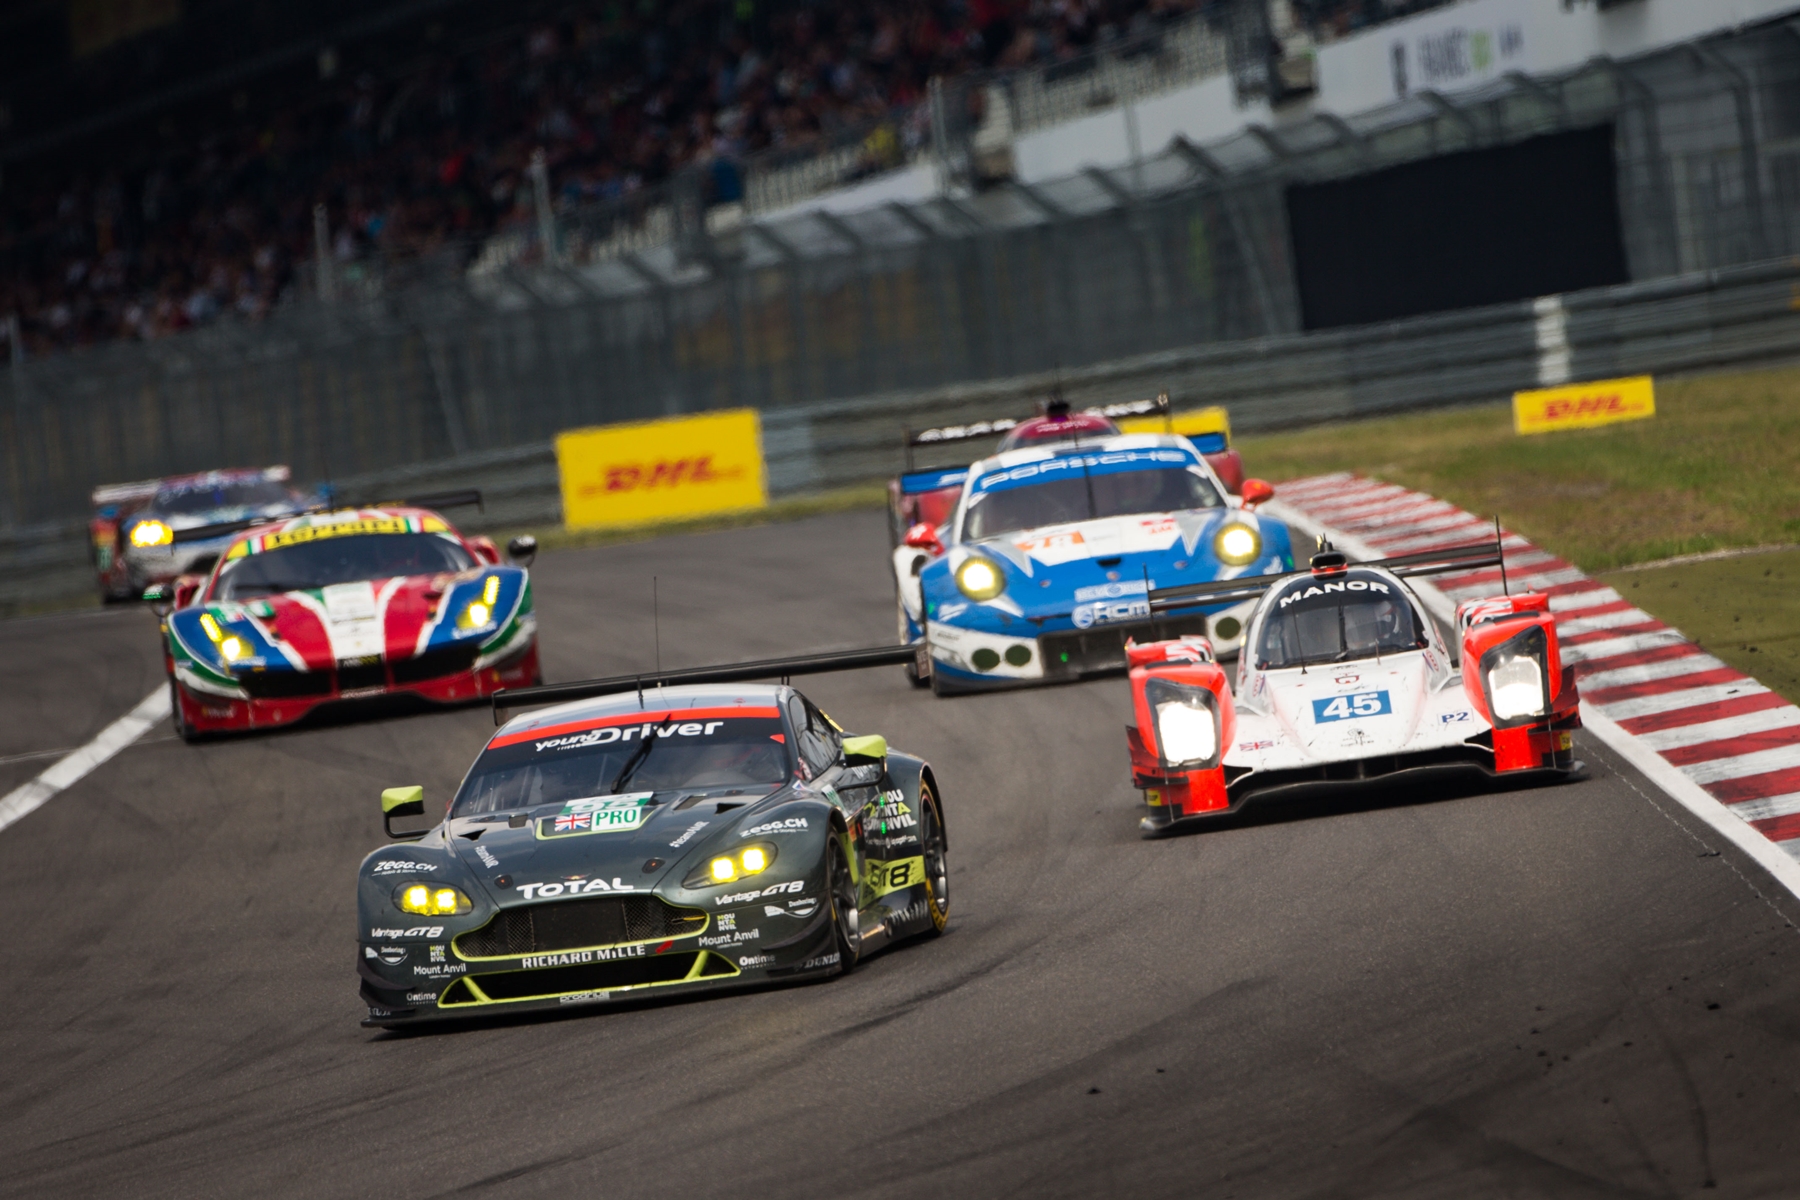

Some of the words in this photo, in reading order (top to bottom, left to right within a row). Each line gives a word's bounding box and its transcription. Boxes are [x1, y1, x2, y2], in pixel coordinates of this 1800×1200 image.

[1544, 394, 1626, 420] DHL
[604, 452, 716, 492] DHL
[980, 450, 1186, 490] PORSCHE
[1279, 580, 1390, 609] MANOR
[1322, 691, 1382, 719] 45
[1441, 711, 1470, 724] P2
[595, 808, 637, 826] PRO
[516, 877, 634, 900] TOTAL
[714, 890, 761, 906] Vantage
[761, 880, 805, 897] GT8
[371, 927, 404, 940] Vantage
[403, 926, 445, 938] GT8
[698, 933, 732, 947] Mount
[733, 928, 760, 942] Anvil
[522, 951, 592, 969] RICHARD
[596, 944, 646, 961] MILLE
[739, 954, 776, 966] Ontime
[413, 965, 441, 976] Mount
[443, 963, 467, 973] Anvil
[406, 992, 437, 1002] Ontime
